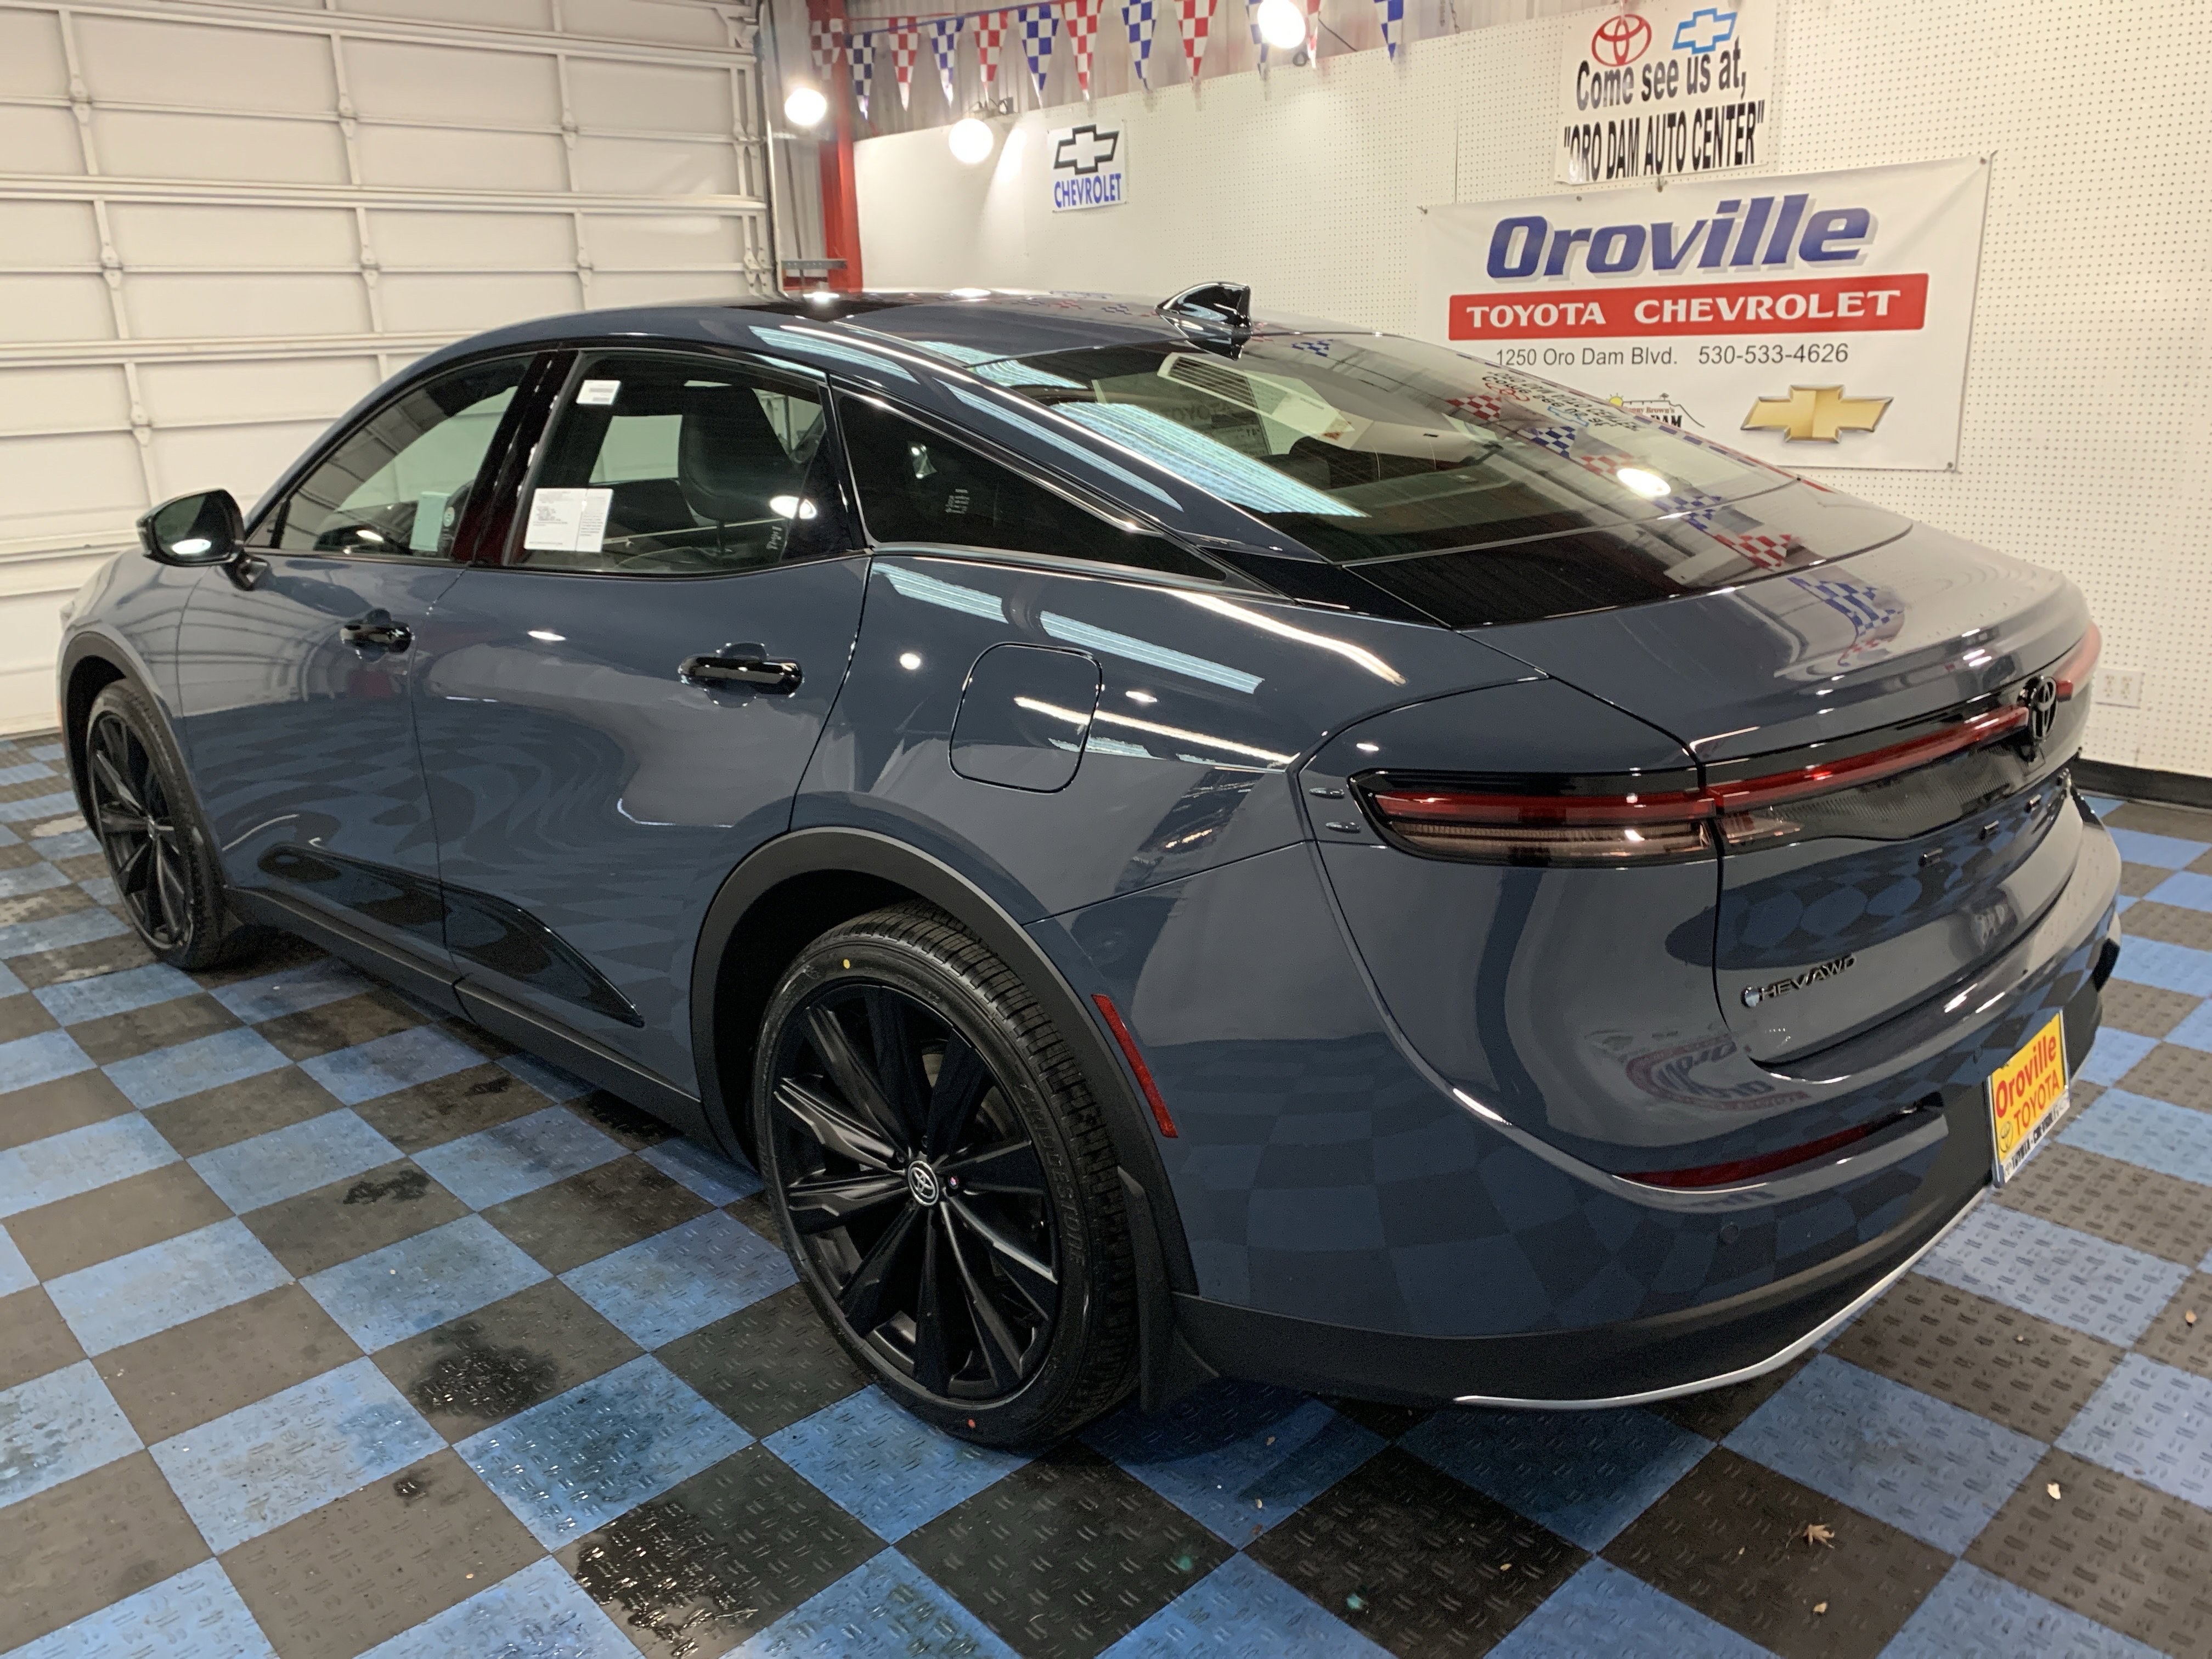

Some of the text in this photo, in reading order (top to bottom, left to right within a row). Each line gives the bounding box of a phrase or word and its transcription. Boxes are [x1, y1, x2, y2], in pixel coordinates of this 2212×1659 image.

[1576, 36, 1747, 111] Come see us at,
[1606, 117, 1640, 180] DAM
[1644, 110, 1687, 176] AUTO
[1692, 99, 1765, 171] CENTER"
[1054, 173, 1121, 208] CHEVROLET
[1487, 193, 1872, 279] Oroville
[1466, 289, 1901, 328] TOYOTA CHEVROLET
[1496, 342, 1849, 366] 1250 Oro Dam Blvd. 530-533-4626
[1996, 1035, 2057, 1118] Oroville
[2013, 1069, 2060, 1136] TOYOTA
